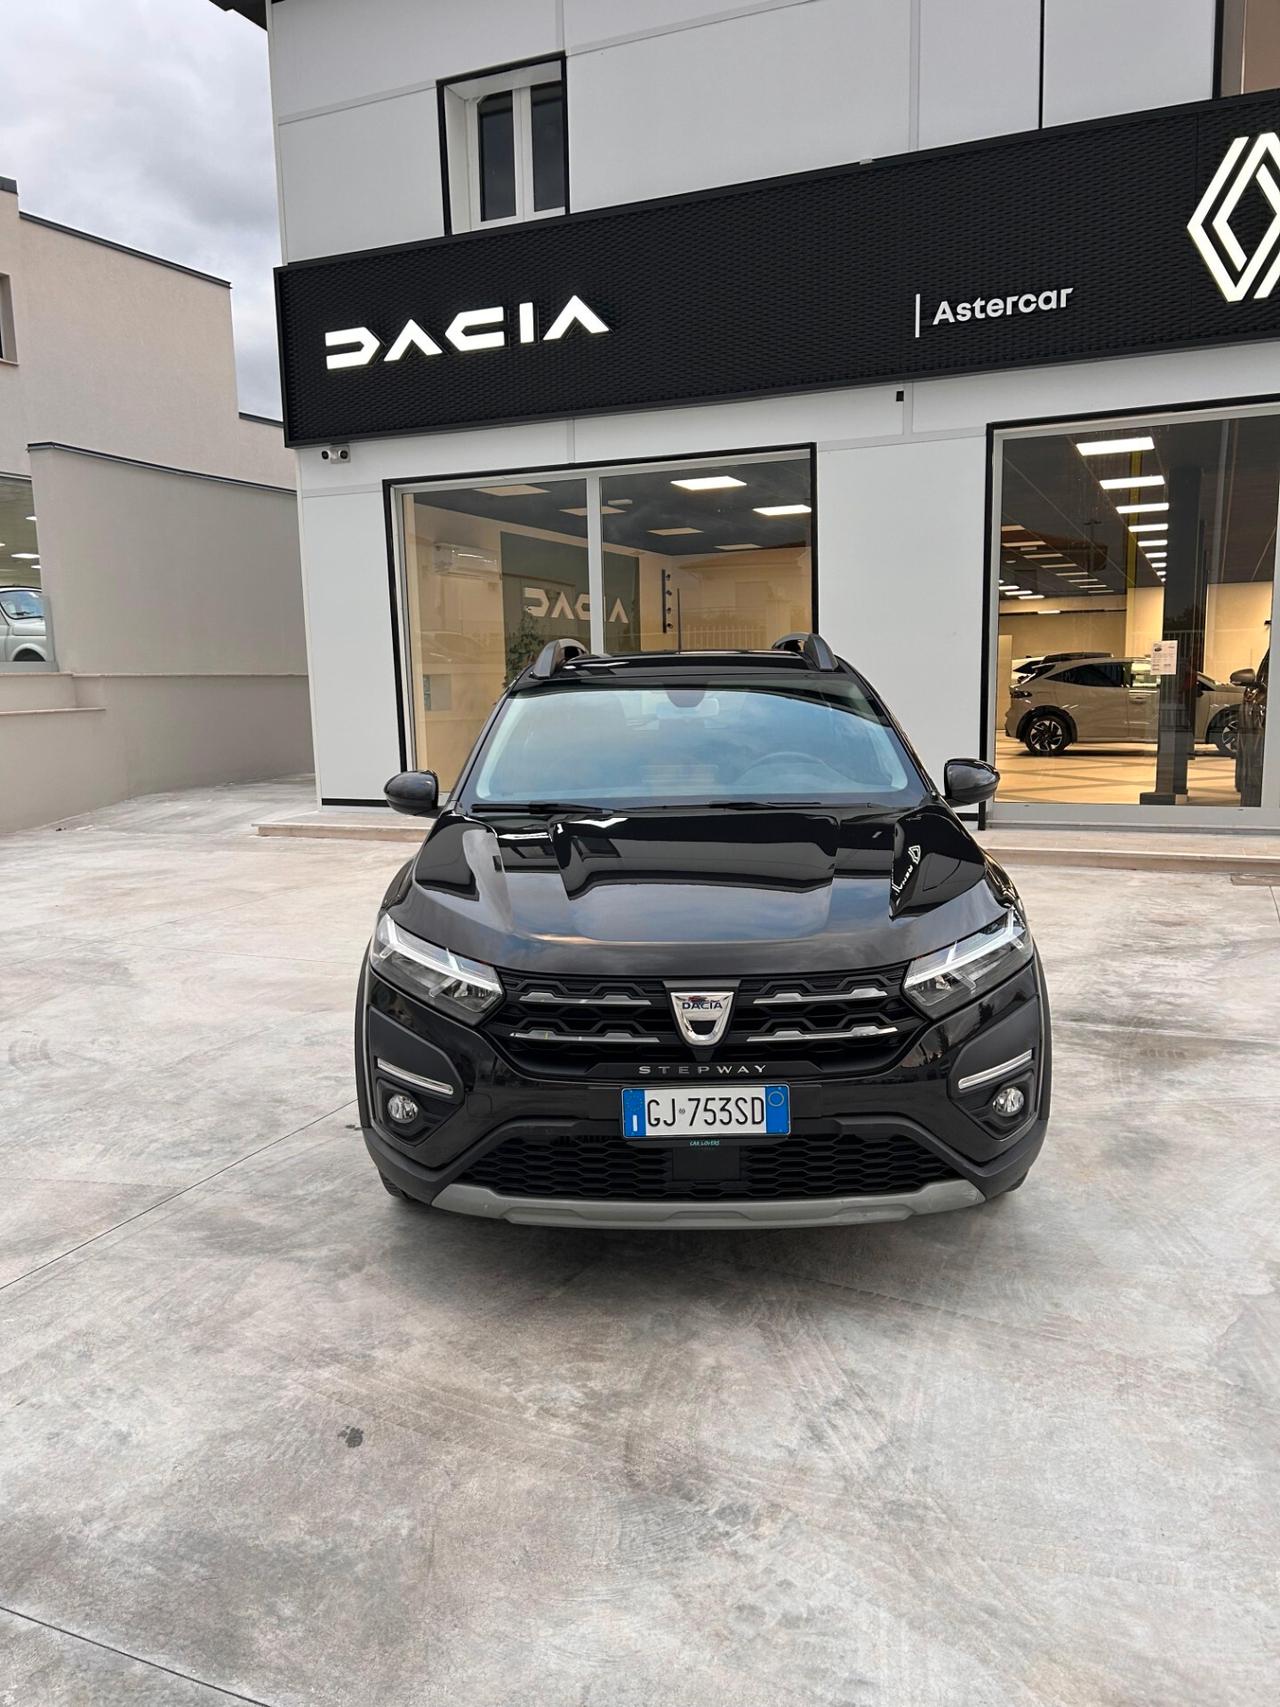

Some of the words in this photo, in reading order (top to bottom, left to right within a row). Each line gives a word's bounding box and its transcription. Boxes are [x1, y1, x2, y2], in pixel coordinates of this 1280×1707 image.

[932, 287, 1074, 326] Astercar
[325, 295, 610, 370] DACIA
[638, 1064, 767, 1074] STEPWAY
